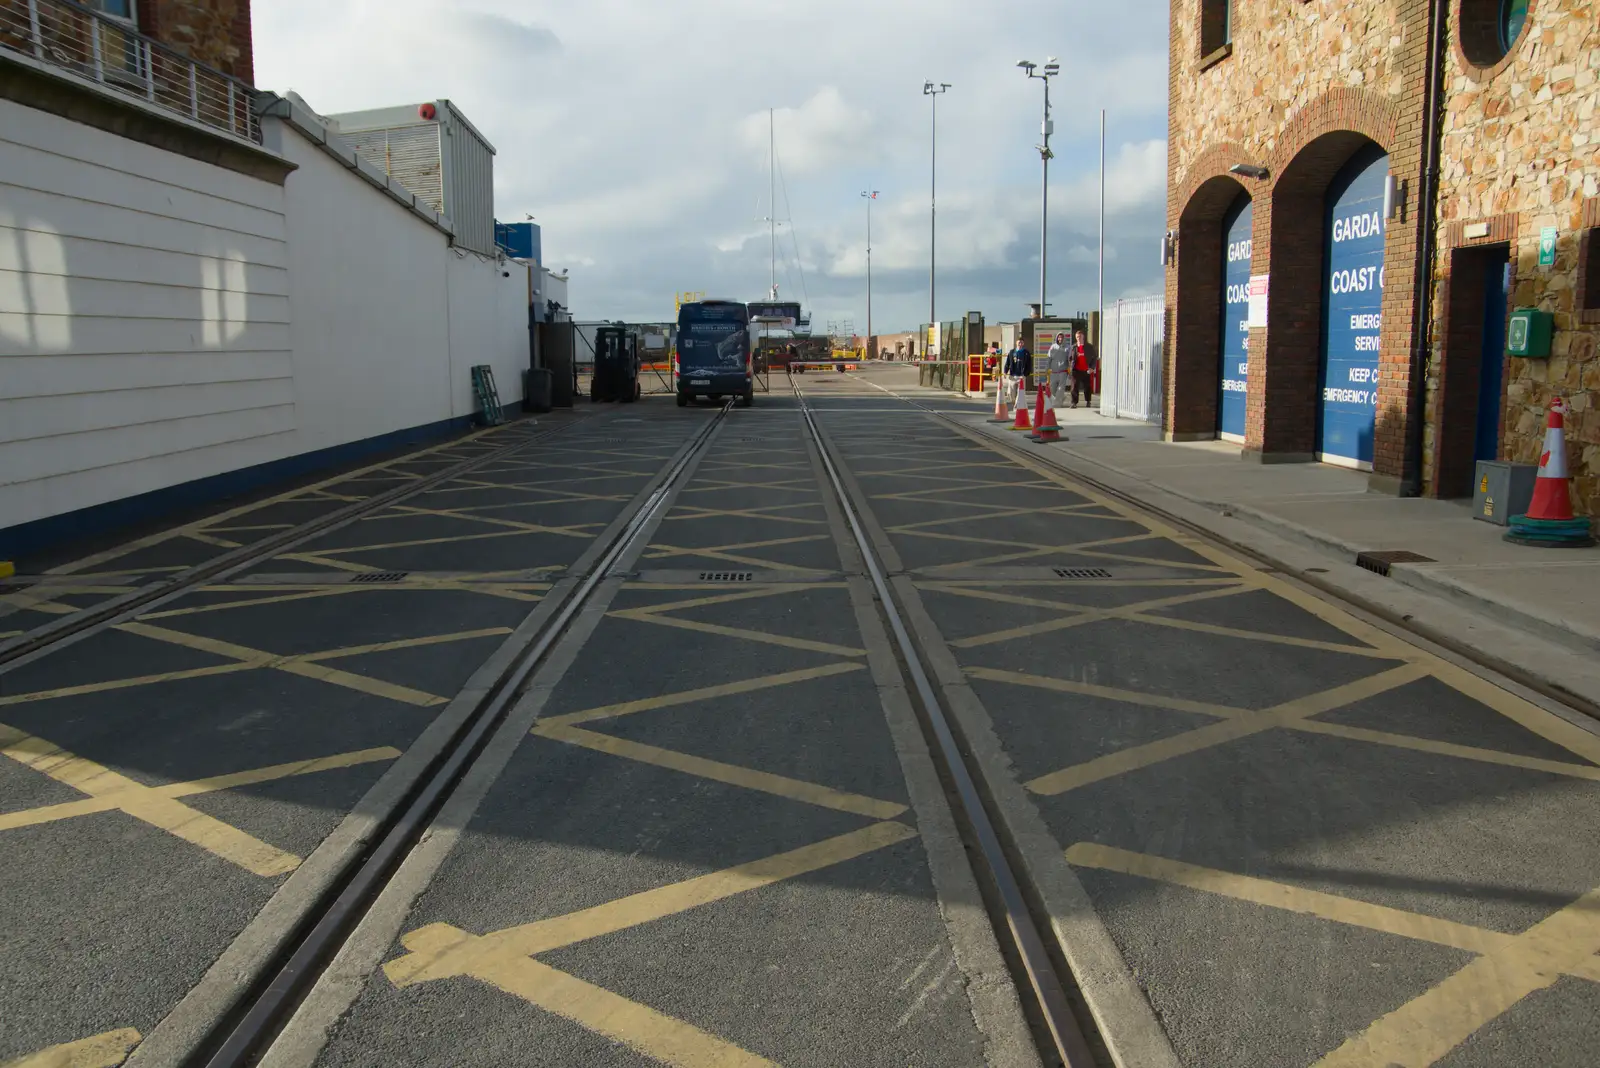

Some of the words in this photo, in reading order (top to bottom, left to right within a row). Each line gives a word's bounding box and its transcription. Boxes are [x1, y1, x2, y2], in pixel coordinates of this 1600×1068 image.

[1333, 211, 1380, 242] GARDA
[1331, 266, 1377, 294] COAST
[1350, 314, 1382, 329] EMERG
[1354, 336, 1381, 351] SERVI
[1349, 367, 1370, 382] KEEP
[1371, 369, 1380, 383] C
[1323, 387, 1369, 404] EMERGENCY
[1371, 392, 1378, 404] C
